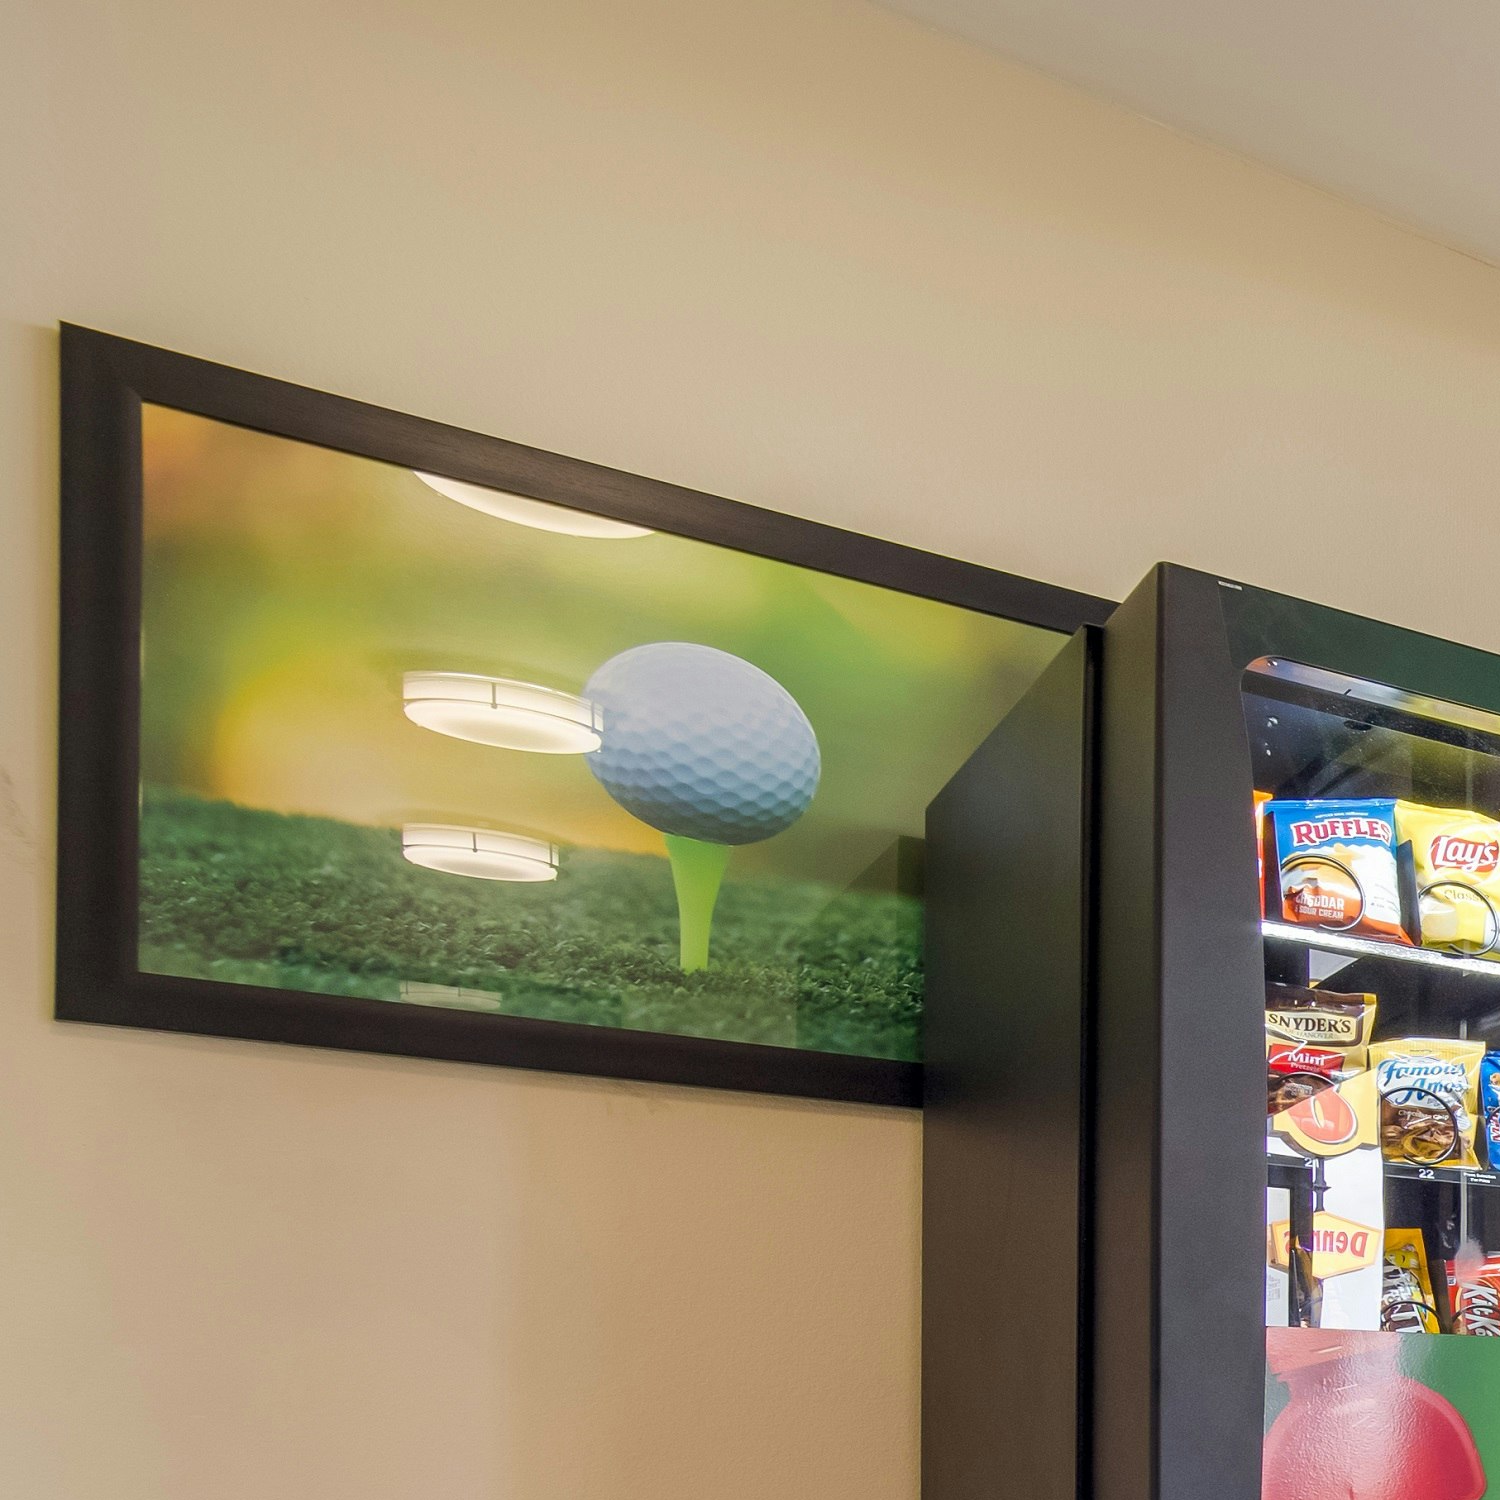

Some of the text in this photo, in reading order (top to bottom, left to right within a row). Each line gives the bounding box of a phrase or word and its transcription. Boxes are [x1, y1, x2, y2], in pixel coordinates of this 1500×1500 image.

[1293, 817, 1392, 846] RUFFLES
[1434, 834, 1499, 872] Lay's
[1268, 1012, 1352, 1034] SNYDER'S
[1287, 1052, 1326, 1067] Mini
[1378, 1059, 1466, 1087] Famous
[1394, 1078, 1464, 1105] Amos
[1418, 1168, 1436, 1180] 22
